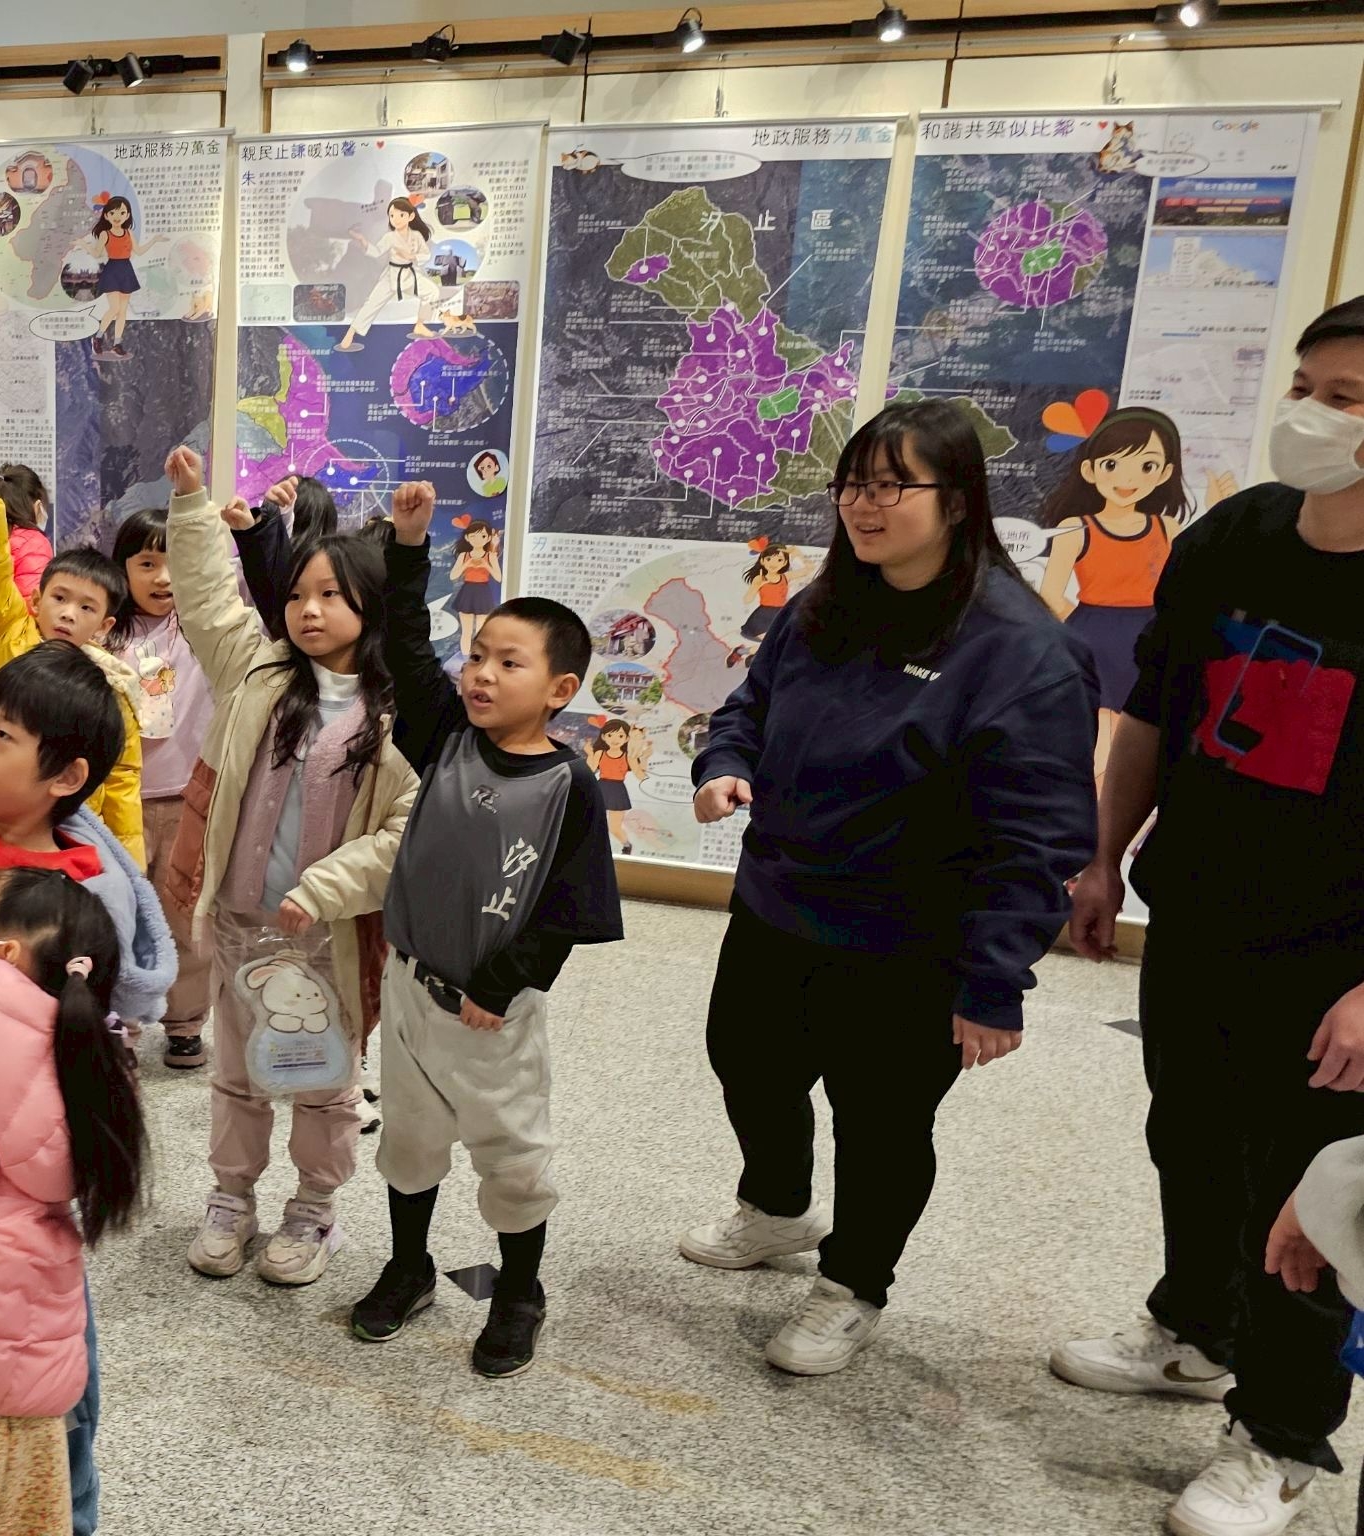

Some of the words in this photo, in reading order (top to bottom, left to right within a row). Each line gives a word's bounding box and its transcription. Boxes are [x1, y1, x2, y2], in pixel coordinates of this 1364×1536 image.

[752, 125, 893, 147] 地政服務汐萬金
[1212, 119, 1261, 133] Google
[114, 139, 221, 160] 地政服務汐萬金
